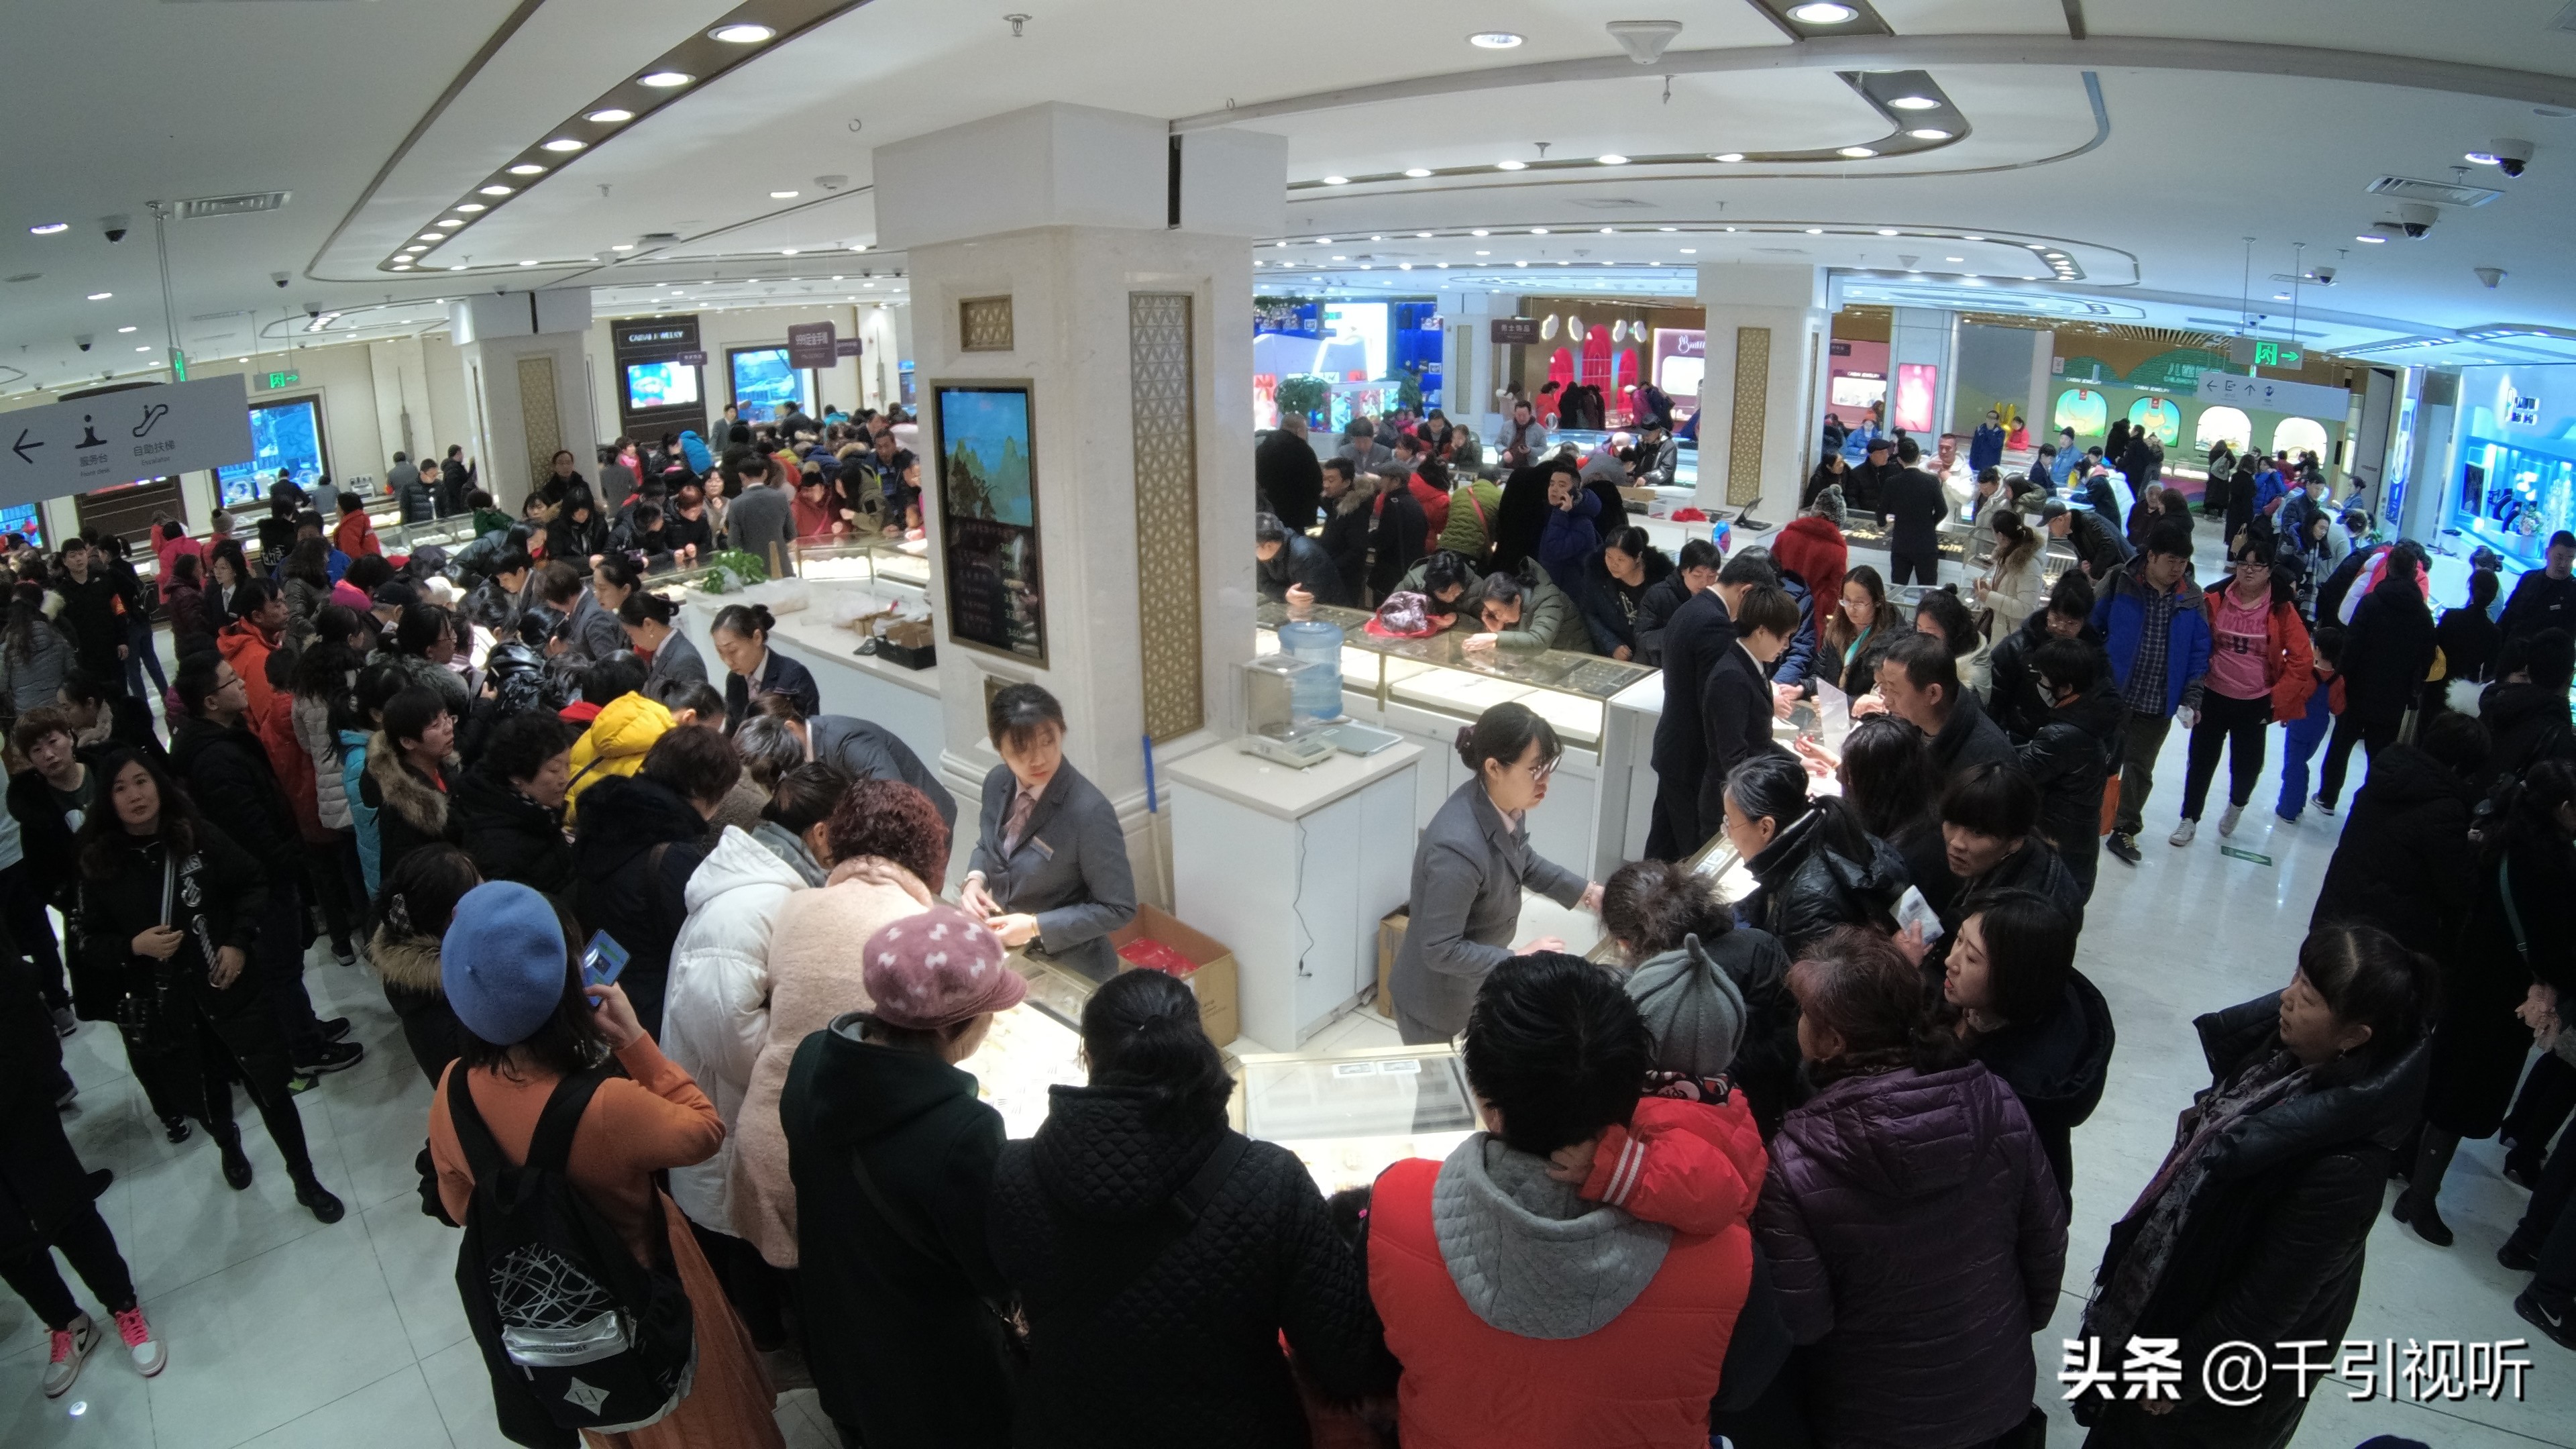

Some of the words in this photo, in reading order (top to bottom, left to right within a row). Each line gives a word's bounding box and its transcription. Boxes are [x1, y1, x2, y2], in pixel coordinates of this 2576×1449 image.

[134, 440, 175, 457] 自助扶梯
[80, 453, 108, 468] 服务台
